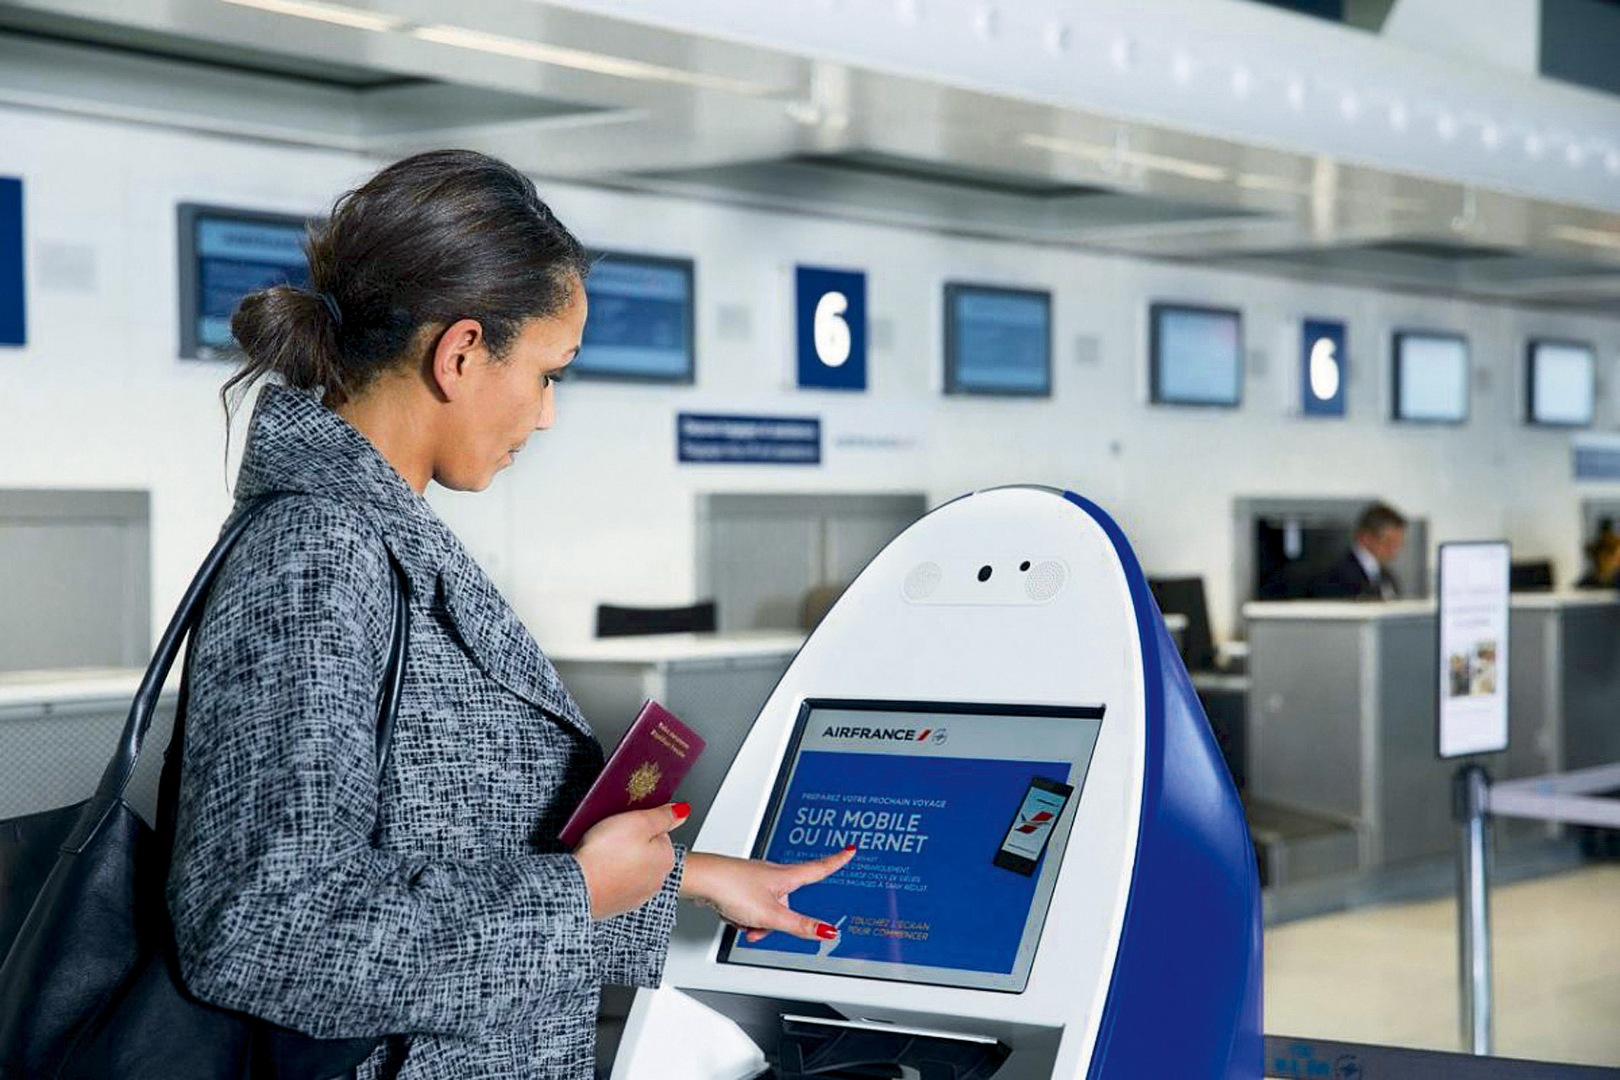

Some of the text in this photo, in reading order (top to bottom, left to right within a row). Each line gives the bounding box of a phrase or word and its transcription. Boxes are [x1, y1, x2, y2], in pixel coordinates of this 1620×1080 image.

[813, 291, 851, 367] 6
[1310, 337, 1339, 400] 6
[822, 726, 916, 740] AIRFRANCE
[842, 795, 867, 804] VOTRE
[868, 796, 910, 806] PROCHAIN
[912, 799, 947, 808] VOYAGE
[795, 807, 921, 832] SUR MOBILE
[789, 827, 929, 854] OU INTERNET
[873, 928, 929, 941] COMMENCER
